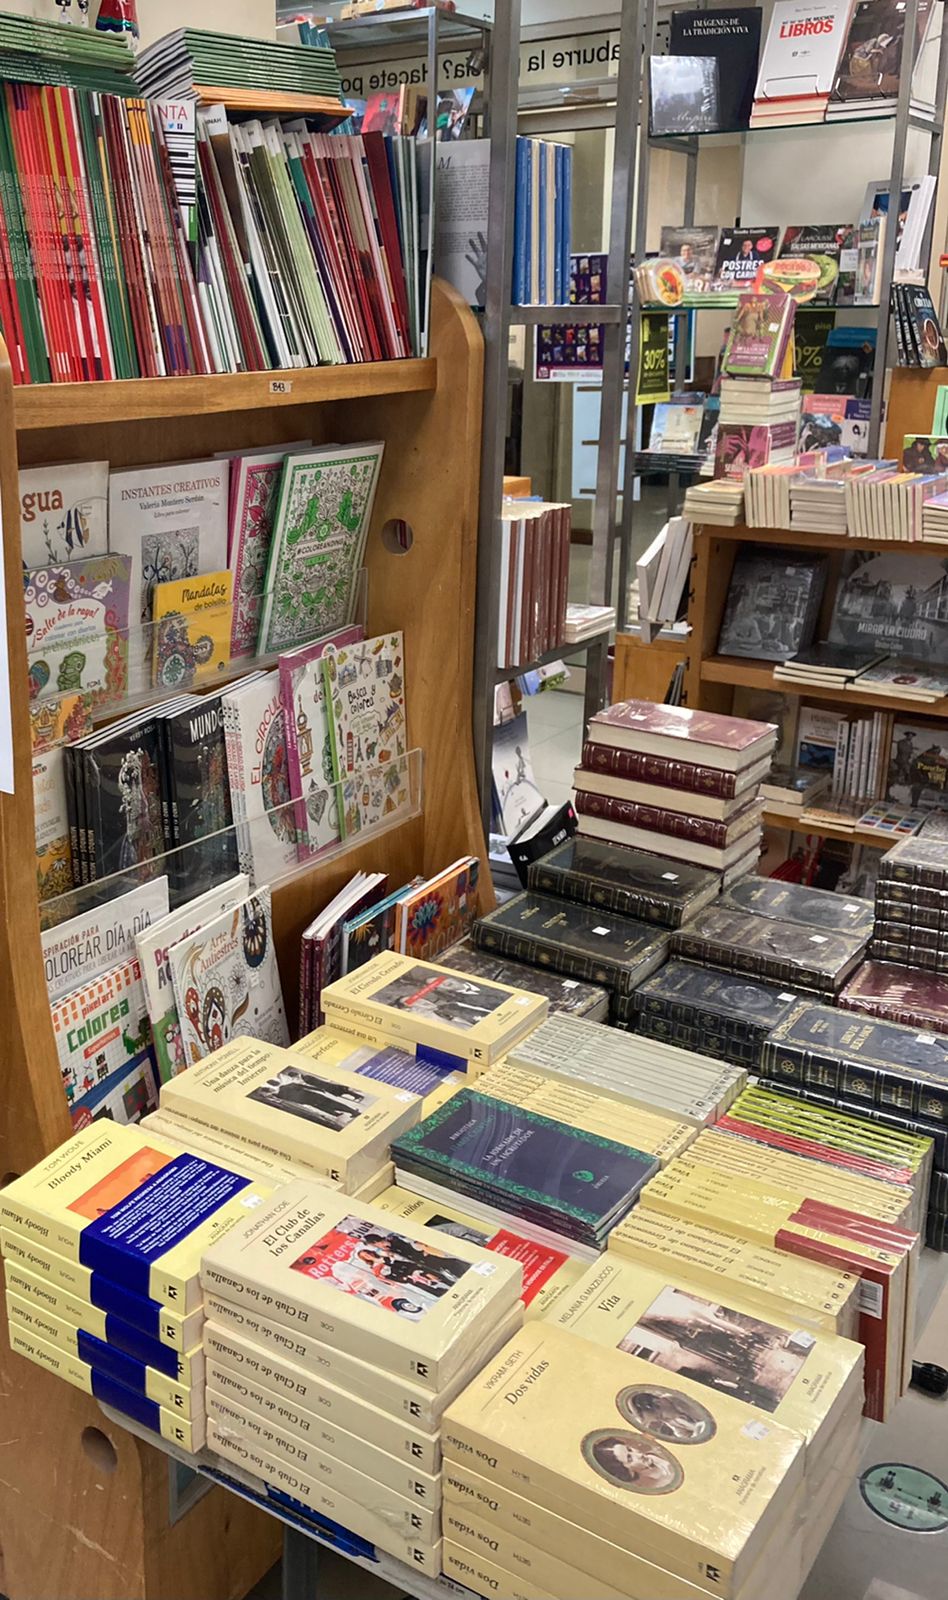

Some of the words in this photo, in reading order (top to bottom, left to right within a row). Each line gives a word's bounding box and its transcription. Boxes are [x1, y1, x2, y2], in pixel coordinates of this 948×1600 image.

[683, 28, 692, 36] LA
[779, 19, 834, 39] LIBROS
[722, 260, 764, 271] POSTRES
[643, 349, 666, 370] 30%
[121, 483, 172, 501] INSTANTES
[173, 476, 221, 493] CREATIVOS
[21, 488, 64, 523] gua
[182, 582, 227, 603] Mandalas
[58, 608, 66, 621] de
[68, 603, 76, 616] la
[194, 602, 203, 611] de
[857, 622, 885, 635] MIRAR
[884, 625, 896, 637] LA
[895, 626, 928, 641] CIUDAD
[348, 686, 368, 705] Busca
[371, 684, 376, 696] y
[350, 696, 375, 715] colorea
[250, 765, 262, 786] EL
[43, 933, 80, 959] SPIRACIÓN
[81, 924, 100, 941] PARA
[211, 931, 228, 950] Arte
[44, 934, 102, 982] OLOREAR
[105, 922, 126, 951] DÍA
[350, 986, 359, 996] El
[66, 997, 130, 1054] Colorea
[373, 1014, 383, 1025] El
[311, 1038, 339, 1060] perfecto
[202, 1075, 219, 1089] Una
[218, 1063, 239, 1083] danza
[239, 1055, 255, 1074] para
[254, 1049, 262, 1059] la
[236, 1069, 248, 1083] del
[42, 1159, 58, 1173] TOM
[57, 1138, 85, 1162] WOLFE
[47, 1162, 83, 1191] Bloody
[80, 1138, 113, 1165] Miami
[483, 1150, 491, 1161] LA
[1, 1207, 24, 1225] Miami
[404, 1199, 425, 1217] niños
[24, 1216, 49, 1238] Bloody
[242, 1211, 275, 1239] JONATHAN
[274, 1200, 291, 1214] COE
[262, 1235, 277, 1248] El
[276, 1217, 298, 1240] Club
[296, 1207, 310, 1223] de
[269, 1240, 286, 1257] los
[283, 1209, 326, 1246] Canallas
[348, 1220, 374, 1241] Club
[4, 1241, 26, 1259] Miami
[26, 1251, 52, 1272] Bloody
[206, 1269, 244, 1294] Canallas
[246, 1287, 260, 1299] los
[261, 1292, 273, 1304] de
[558, 1295, 583, 1325] MELANIA
[584, 1264, 614, 1296] MAZZUCCO
[598, 1292, 621, 1314] Vita
[207, 1299, 245, 1324] Canallas
[275, 1300, 296, 1317] Club
[298, 1312, 309, 1323] El
[245, 1317, 259, 1331] los
[260, 1325, 272, 1337] de
[273, 1333, 295, 1350] Club
[296, 1346, 307, 1357] El
[483, 1366, 507, 1392] VIKRAM
[504, 1349, 523, 1371] SETH
[504, 1382, 528, 1406] Dos
[525, 1357, 550, 1386] vidas
[446, 1434, 474, 1459] vidas
[476, 1451, 498, 1468] Dos
[447, 1477, 475, 1502] vidas
[476, 1494, 499, 1512] Dos
